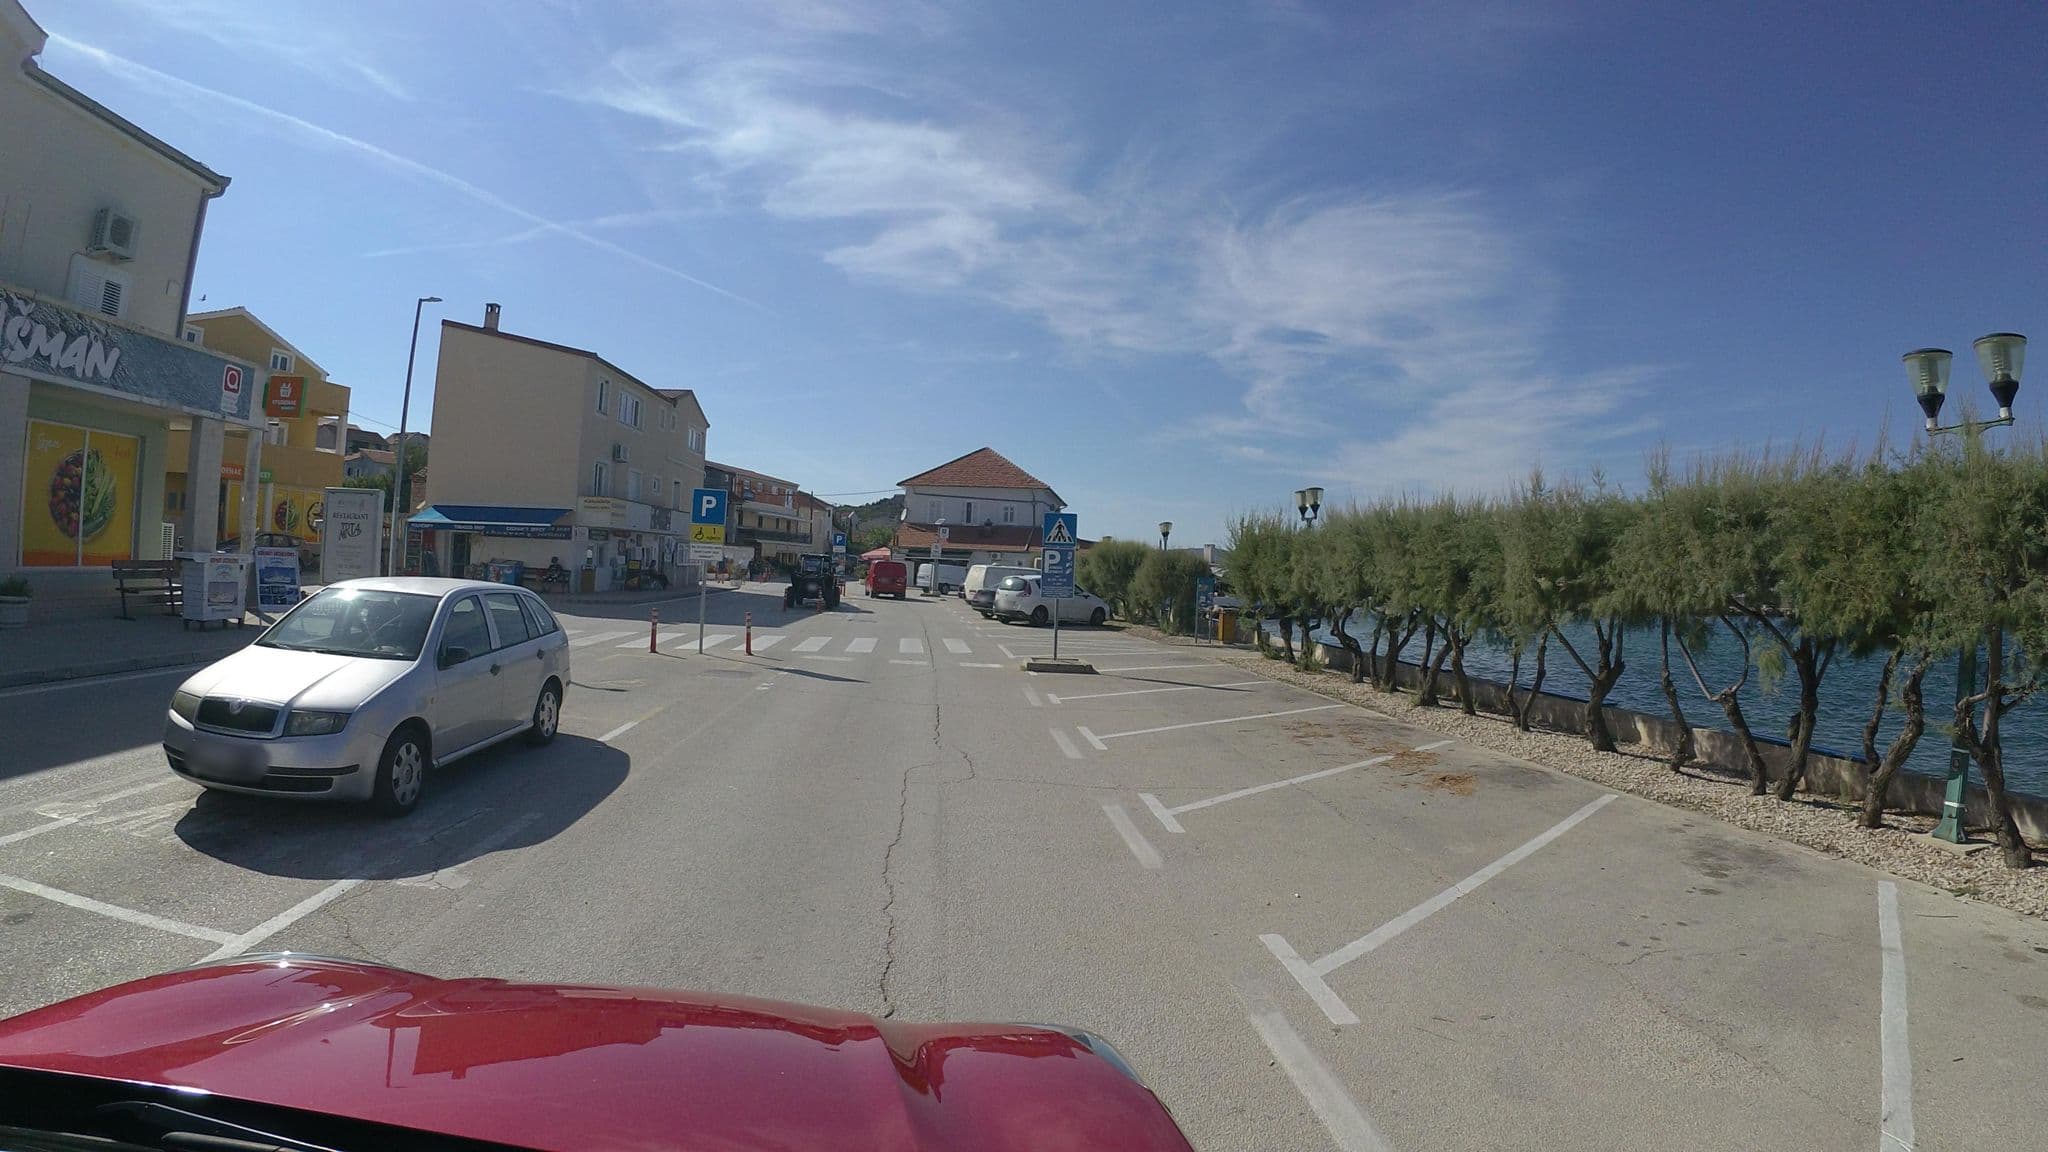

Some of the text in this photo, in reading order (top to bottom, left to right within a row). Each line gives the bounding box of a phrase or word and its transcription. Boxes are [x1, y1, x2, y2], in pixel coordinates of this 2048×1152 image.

[221, 466, 243, 475] DENAC
[702, 496, 717, 517] P
[332, 512, 369, 521] RESTAURANT
[836, 535, 843, 545] P
[1044, 550, 1061, 574] P
